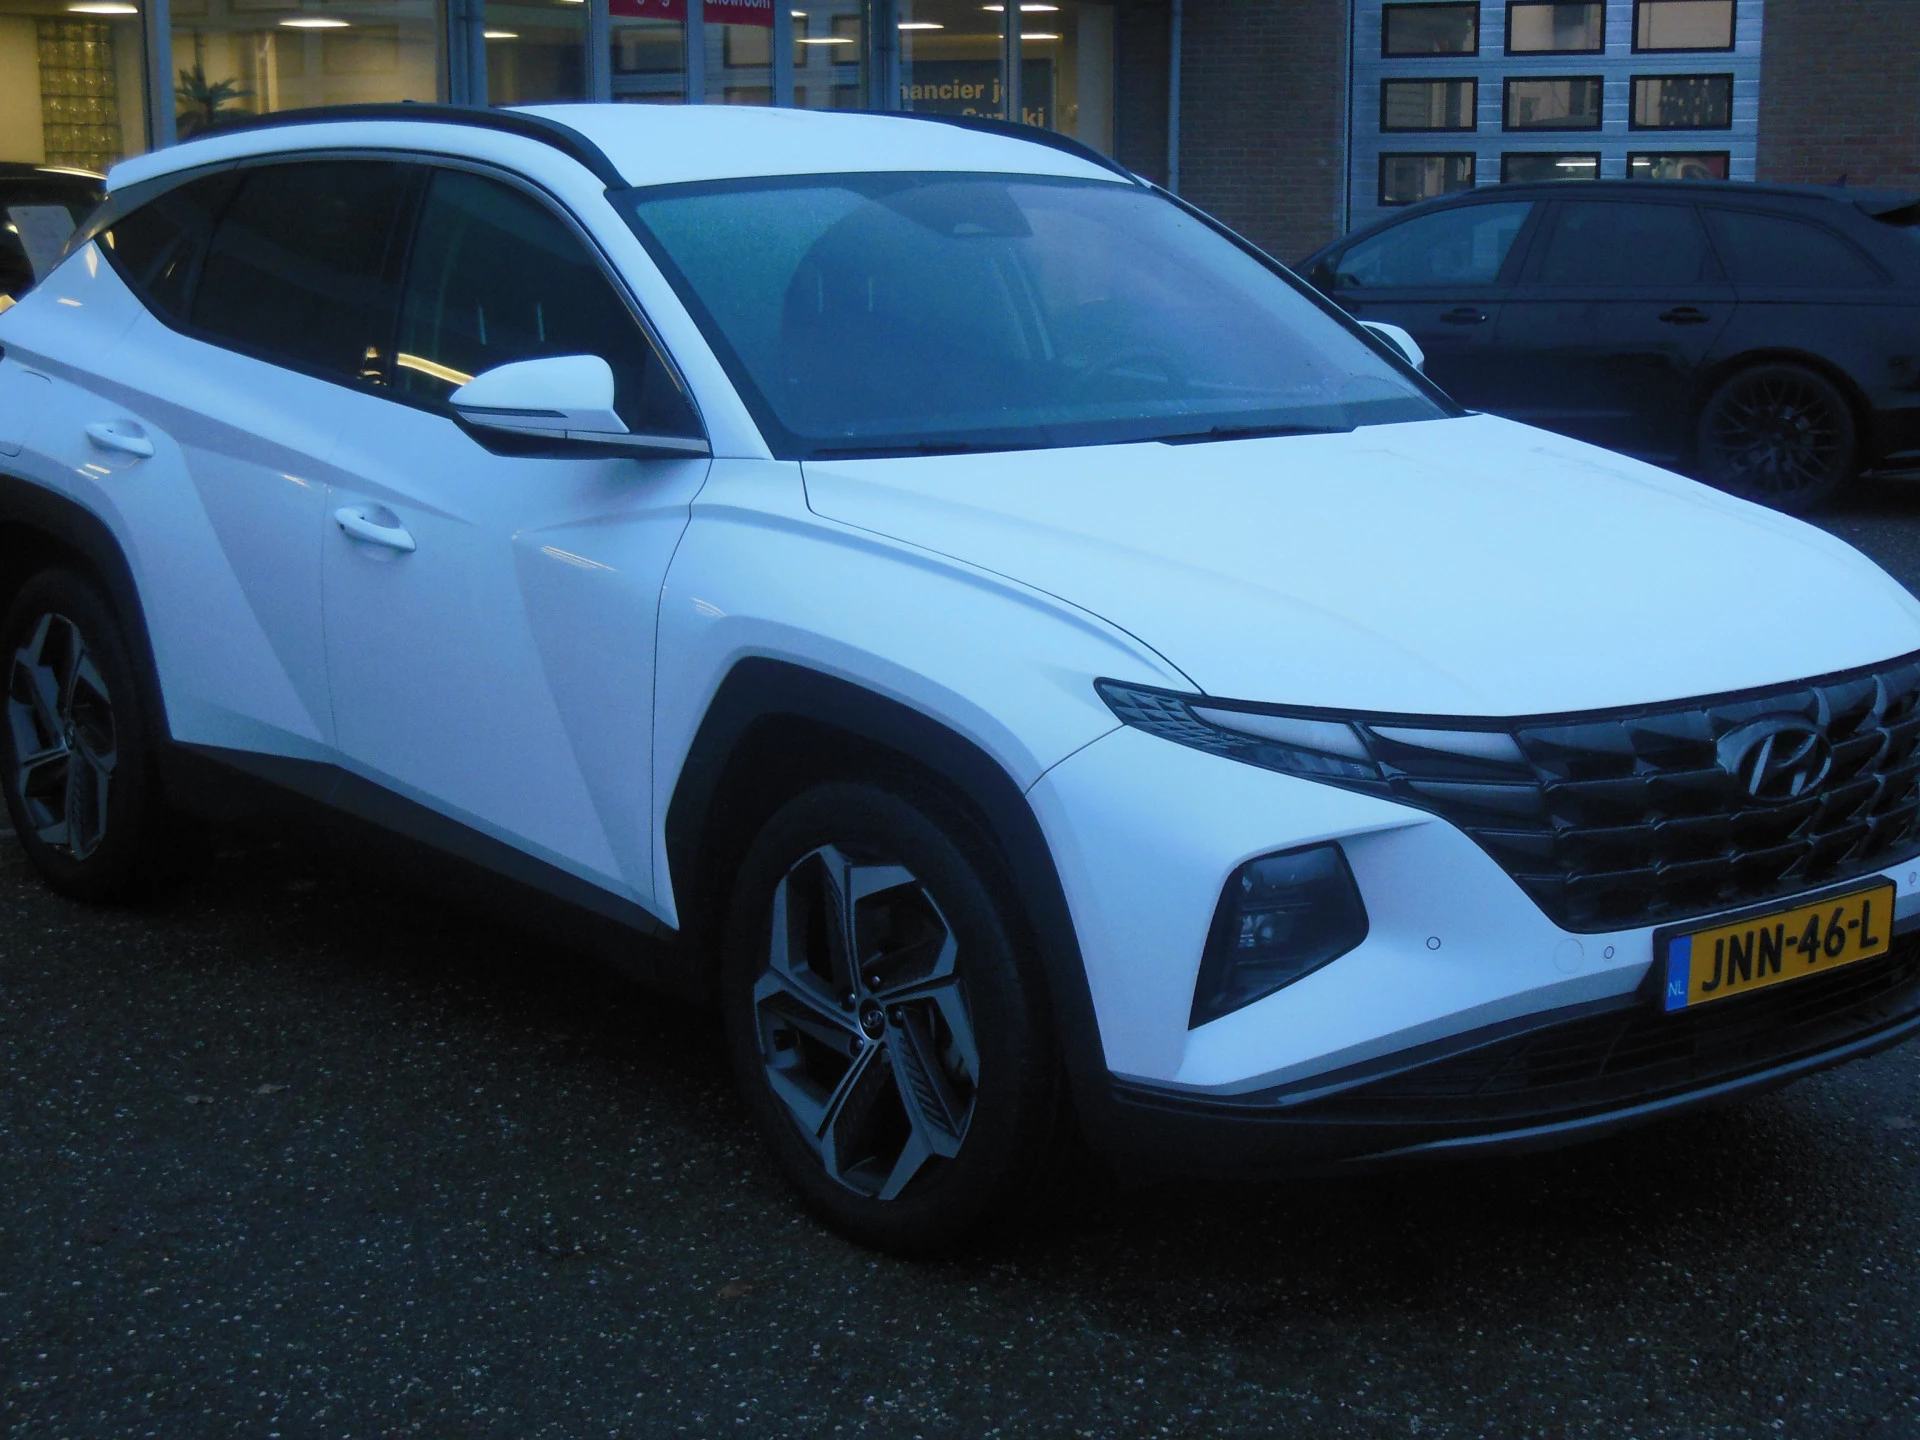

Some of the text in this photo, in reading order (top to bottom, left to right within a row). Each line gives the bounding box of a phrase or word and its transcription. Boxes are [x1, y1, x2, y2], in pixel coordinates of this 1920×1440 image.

[992, 79, 1005, 104] j
[1701, 898, 1879, 993] JNN-46-L
[1668, 981, 1685, 997] NL
